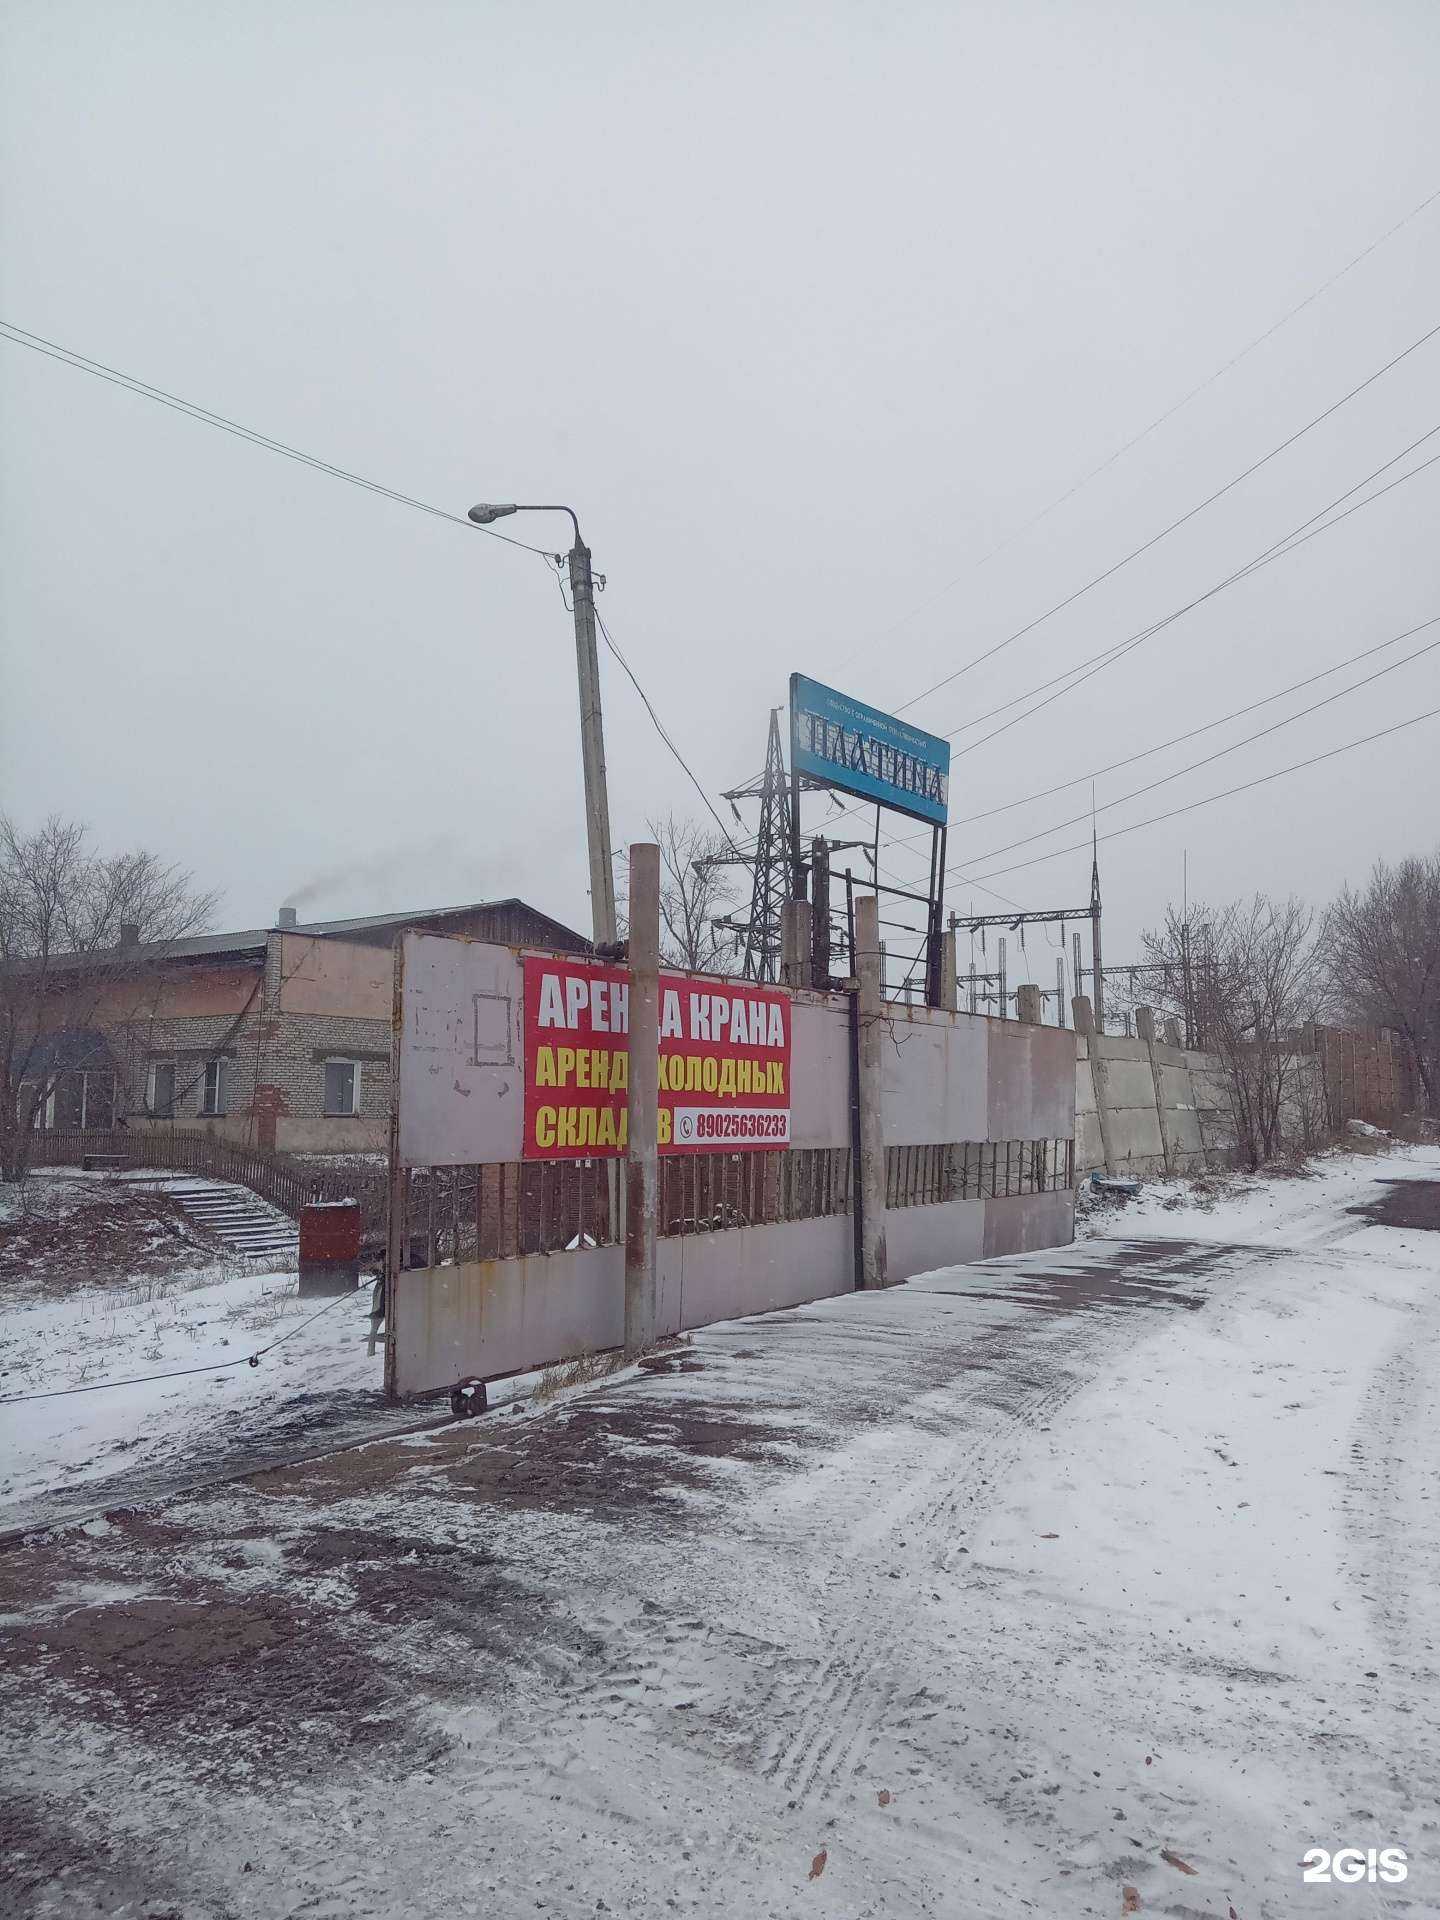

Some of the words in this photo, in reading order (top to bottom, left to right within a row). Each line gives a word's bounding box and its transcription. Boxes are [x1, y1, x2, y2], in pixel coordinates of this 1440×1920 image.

[537, 973, 683, 1046] АРЕНА
[689, 992, 786, 1048] КРАНА
[535, 1046, 629, 1096] АРЕНД
[535, 1105, 672, 1152] СКЛАВ
[696, 1113, 787, 1138] 89025636233
